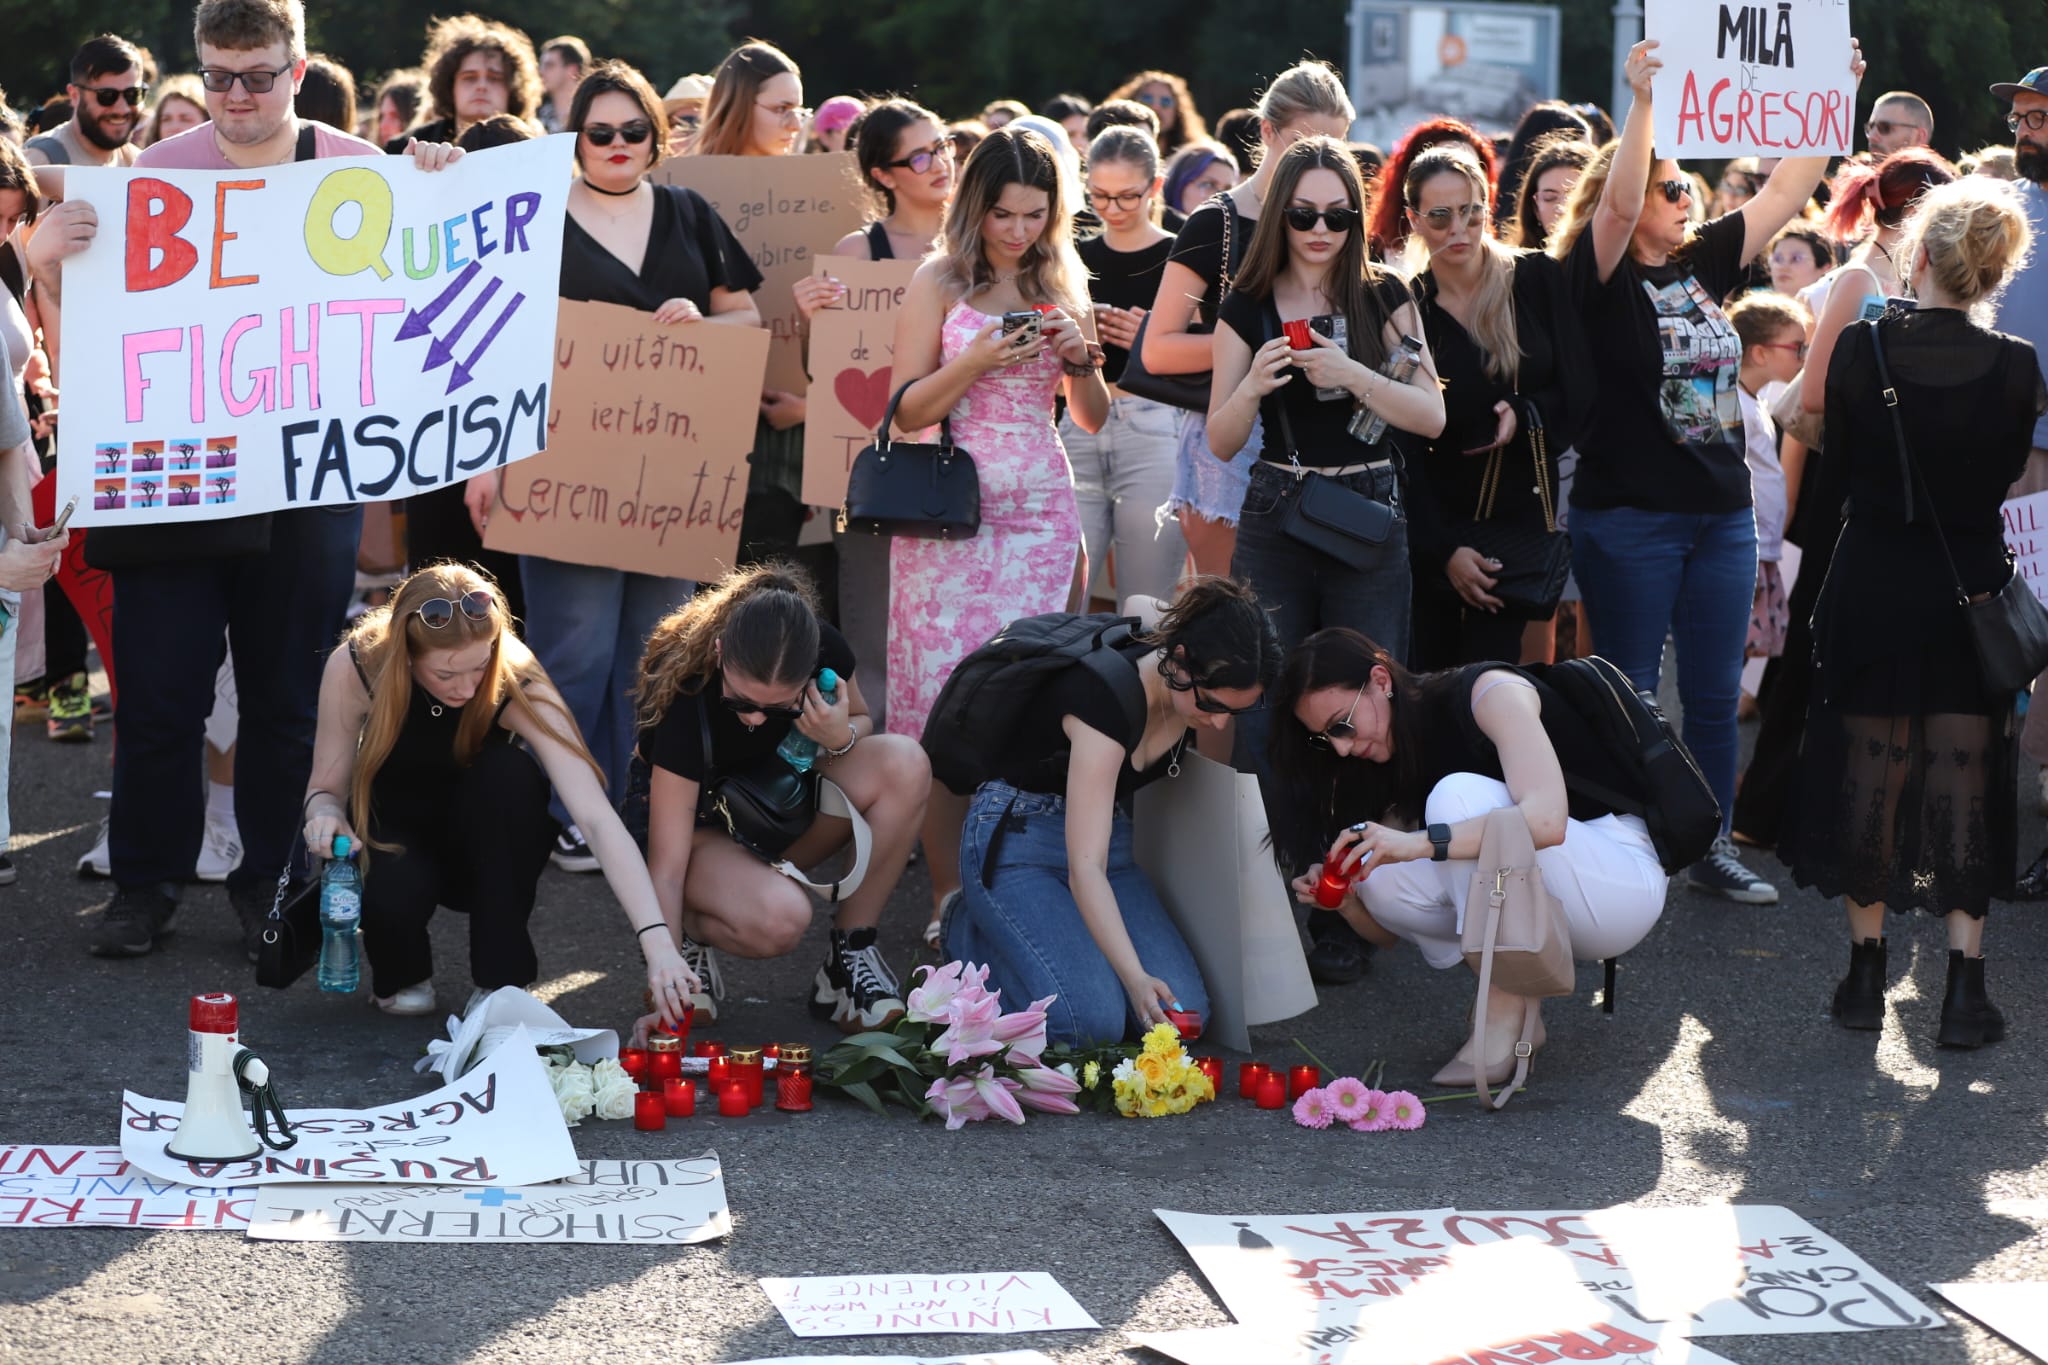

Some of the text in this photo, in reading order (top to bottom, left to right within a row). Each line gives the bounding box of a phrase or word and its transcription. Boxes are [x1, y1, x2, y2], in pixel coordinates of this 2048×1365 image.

[1676, 68, 1851, 152] AGRESORI
[1740, 63, 1762, 93] DE
[124, 176, 266, 292] BE
[121, 297, 406, 424] FIGHT
[850, 330, 869, 361] de
[280, 381, 548, 502] FASCISM
[616, 453, 743, 547] dreptate
[826, 1275, 1035, 1297] VIOLENCE
